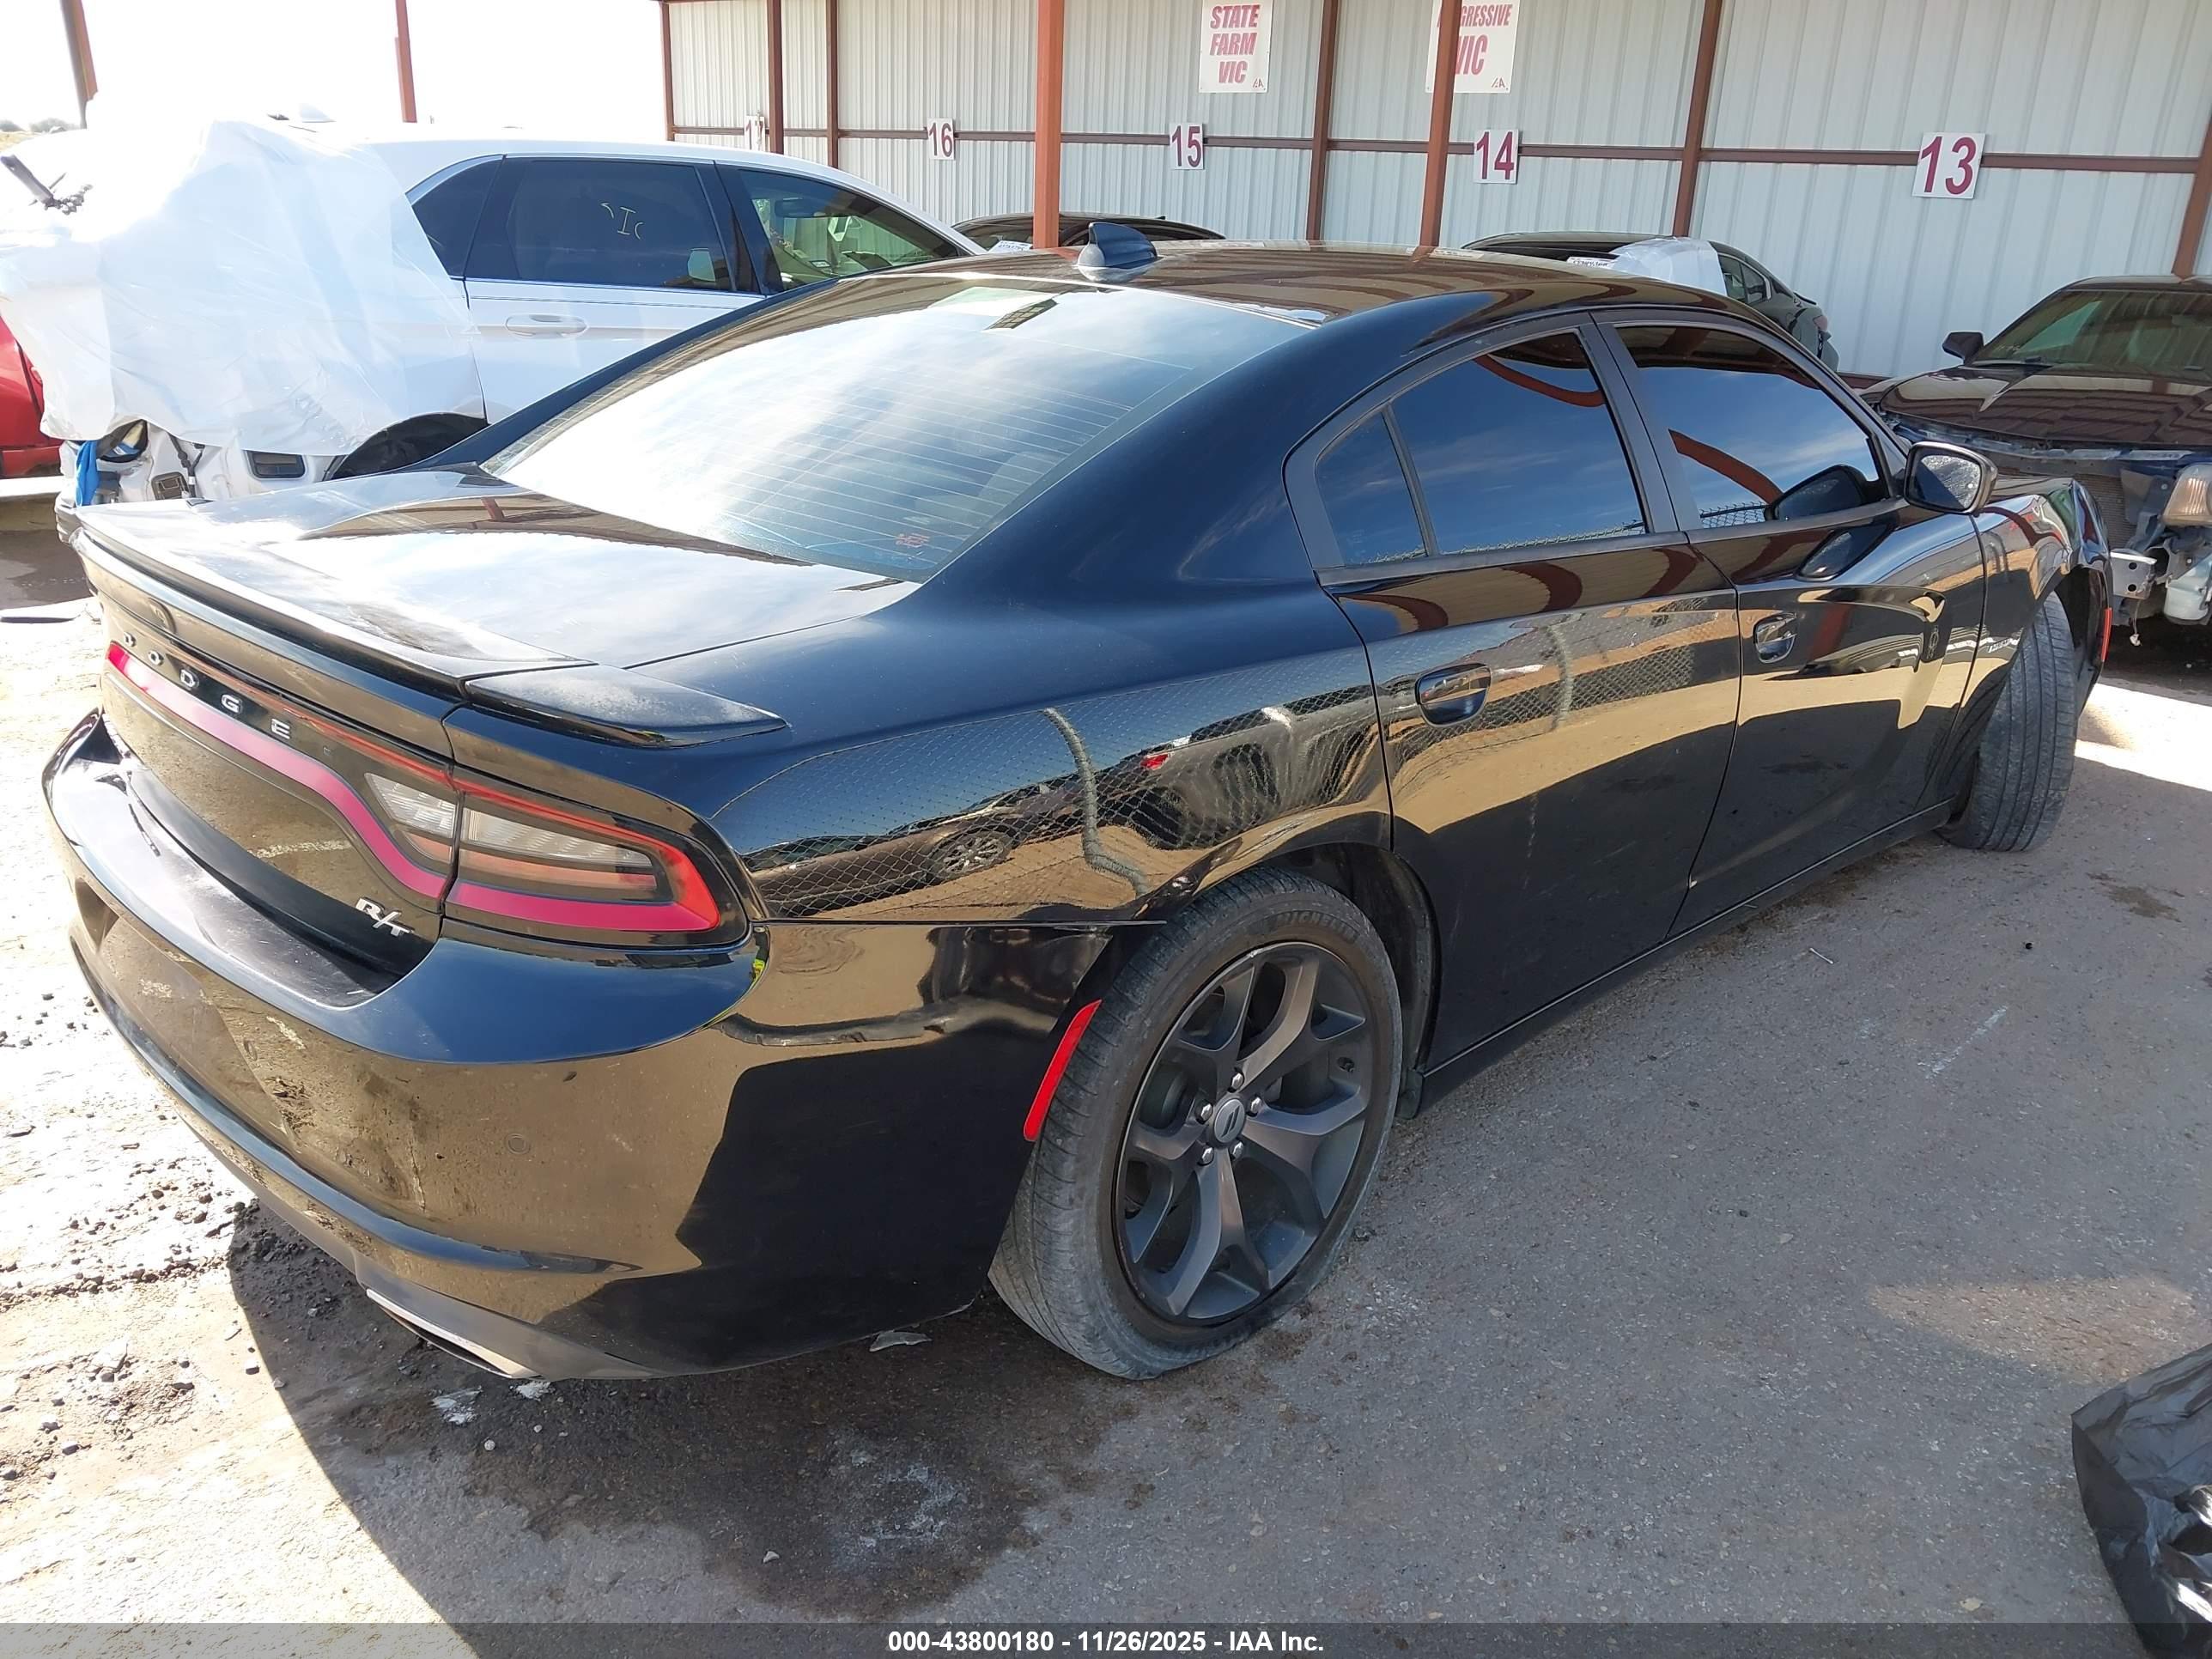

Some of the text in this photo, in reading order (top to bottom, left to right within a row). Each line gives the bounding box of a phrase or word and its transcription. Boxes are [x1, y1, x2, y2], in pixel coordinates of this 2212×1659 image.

[1210, 4, 1261, 29] STATE
[1209, 33, 1258, 56] FARM
[1455, 34, 1488, 76] VIC
[1218, 61, 1248, 83] VIC
[928, 122, 953, 157] 16
[1171, 125, 1201, 167] 15
[1476, 131, 1515, 180] 14
[1920, 136, 1977, 195] 13
[123, 631, 291, 740] DODGE
[355, 897, 412, 937] R/T
